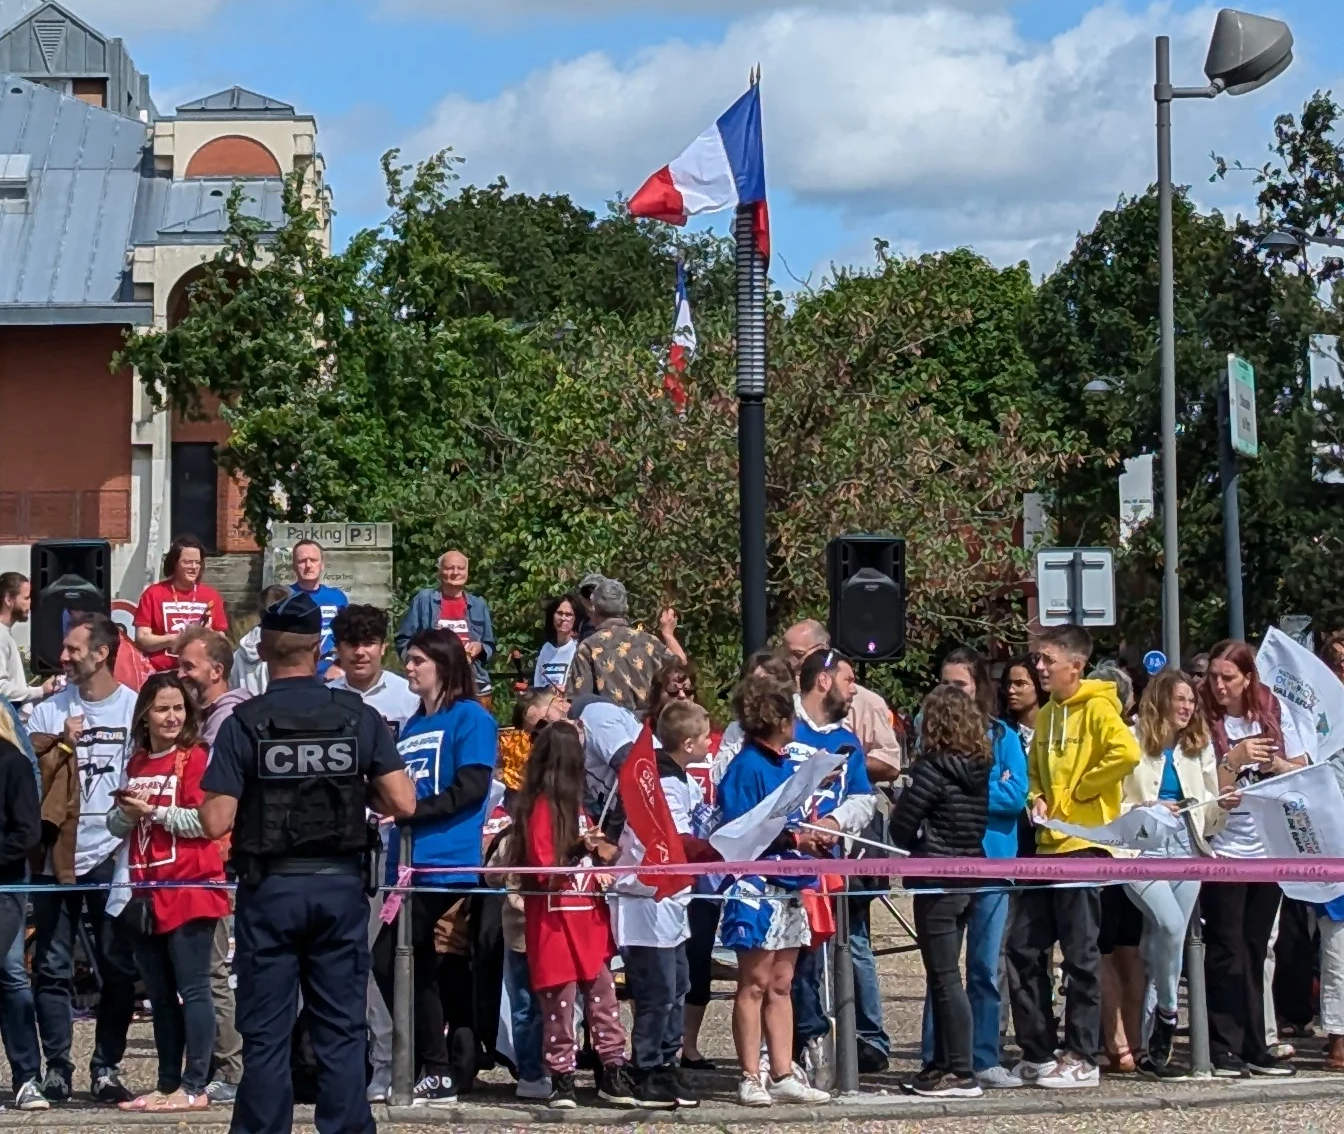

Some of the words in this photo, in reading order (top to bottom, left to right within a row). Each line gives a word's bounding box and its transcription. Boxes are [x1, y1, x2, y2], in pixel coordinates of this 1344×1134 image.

[287, 527, 342, 543] Parking
[350, 528, 361, 542] P
[364, 530, 372, 541] 3
[265, 743, 353, 774] CRS
